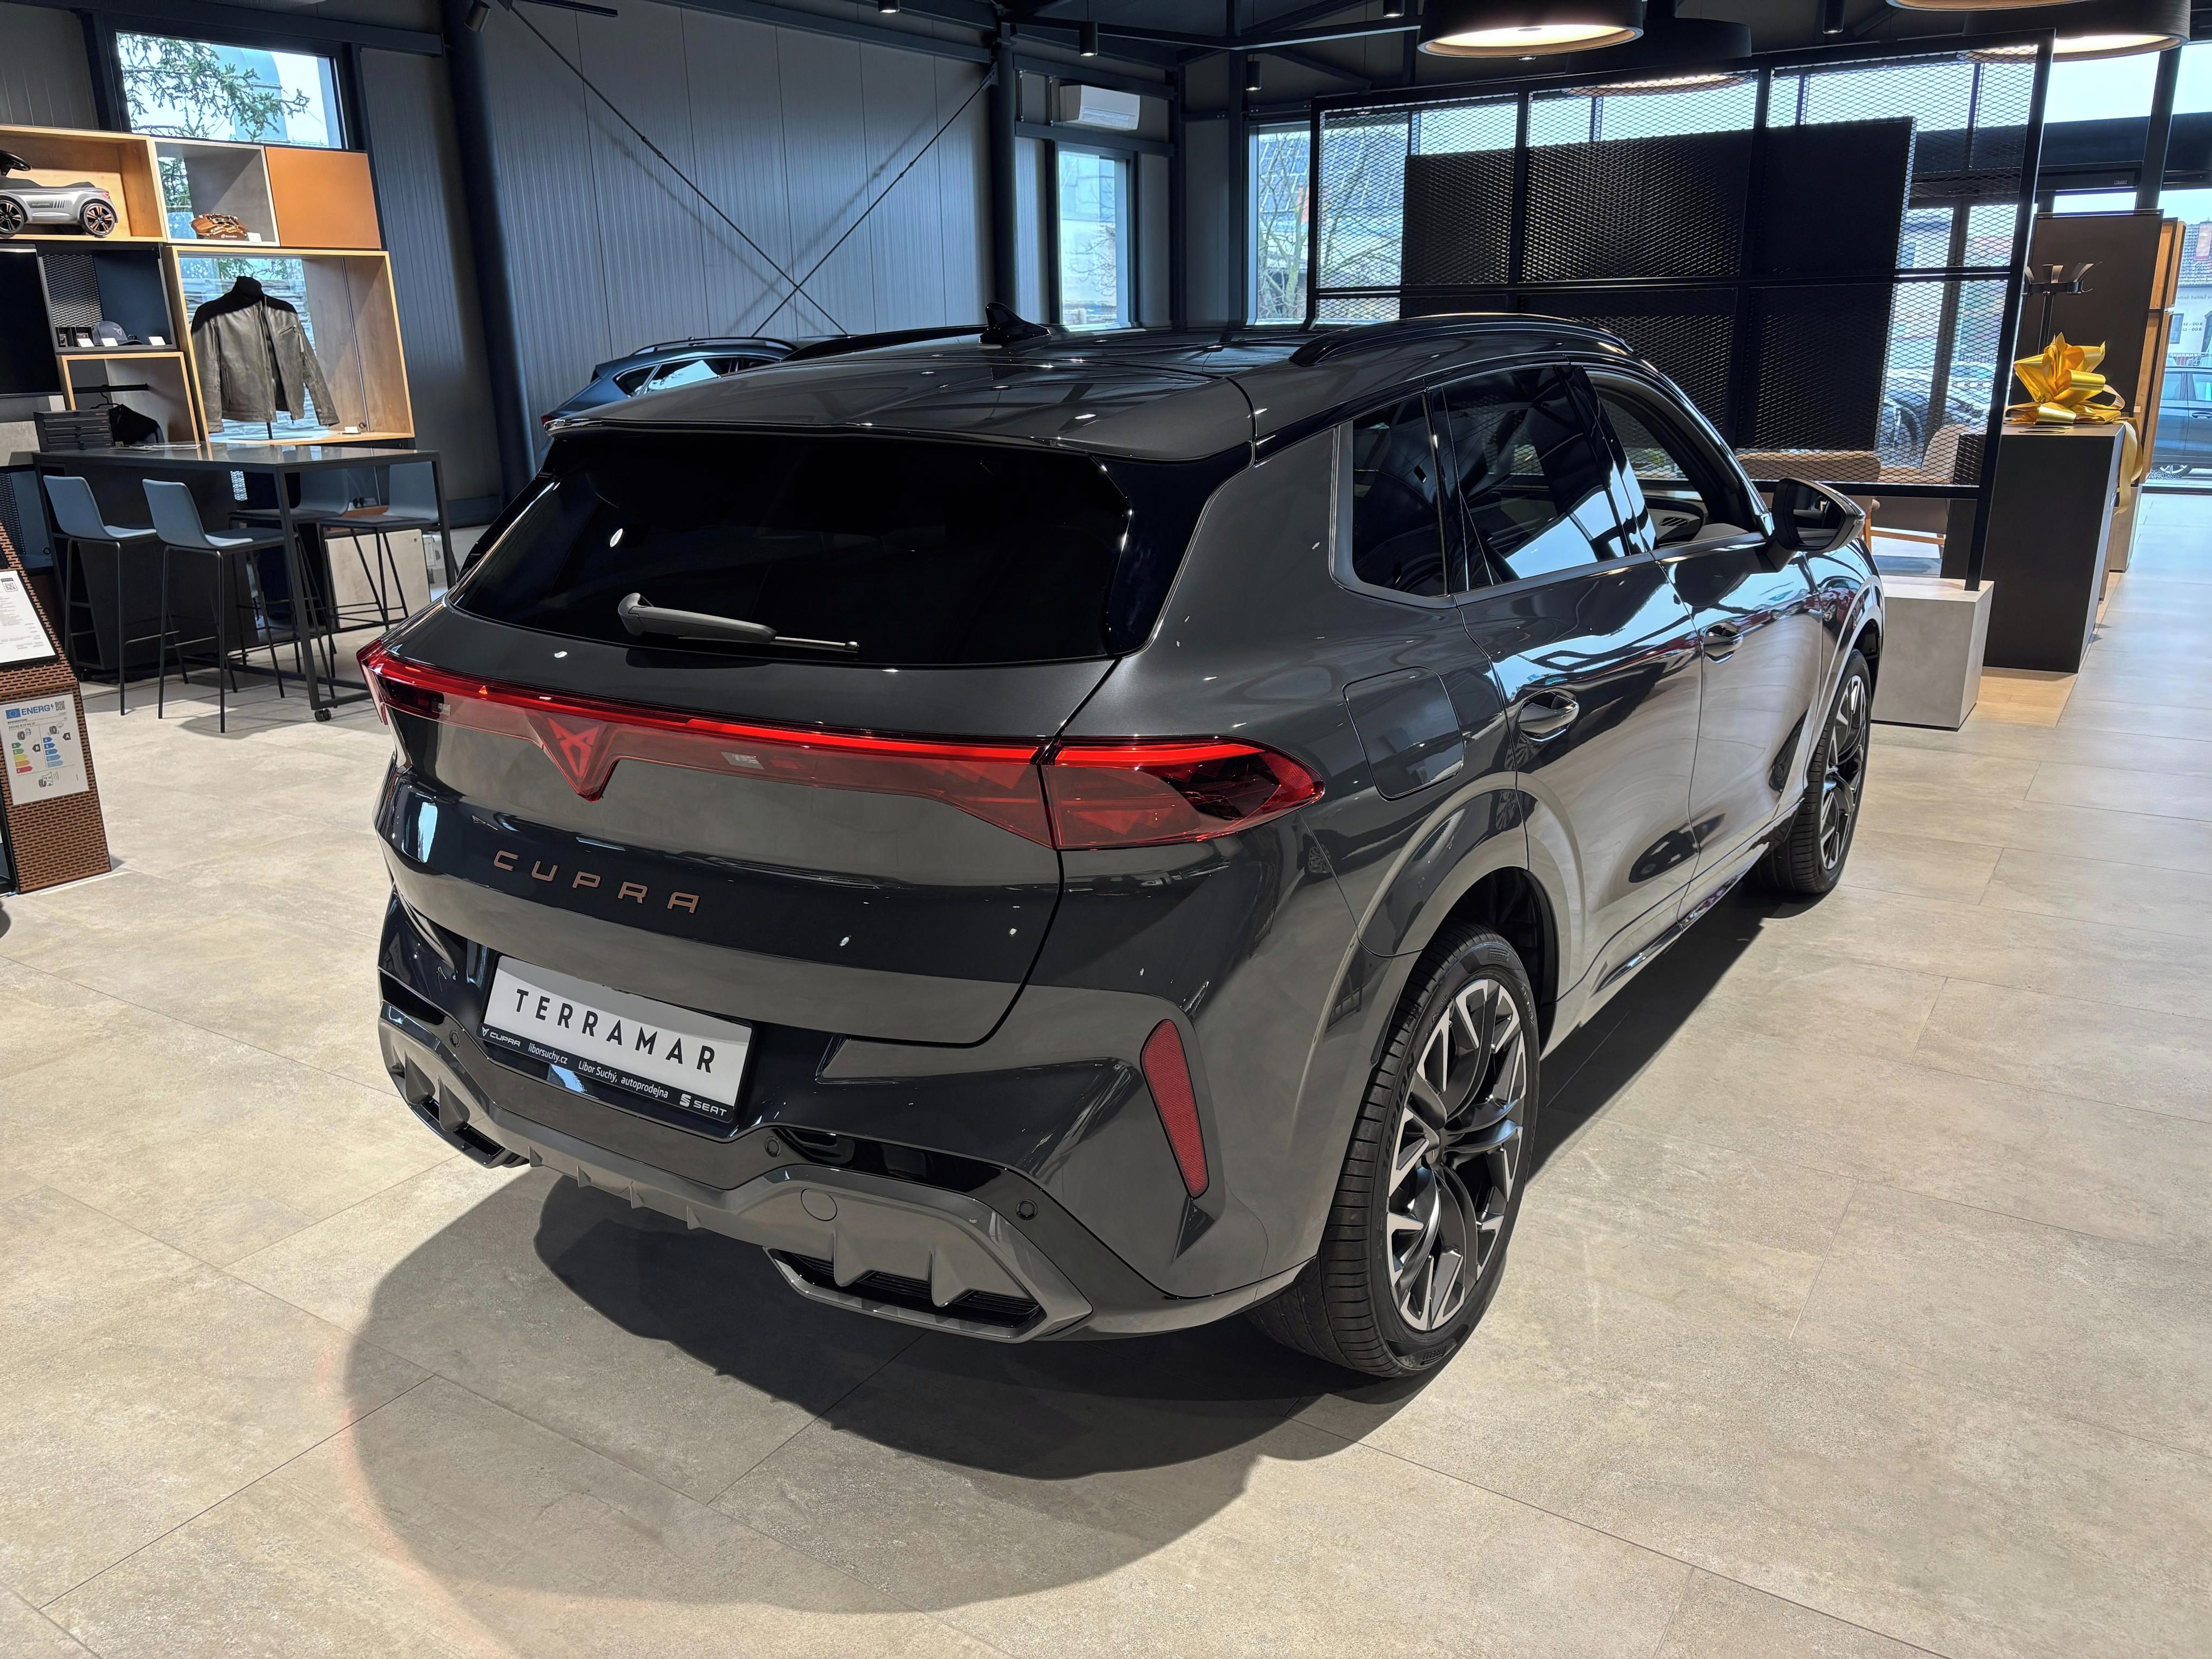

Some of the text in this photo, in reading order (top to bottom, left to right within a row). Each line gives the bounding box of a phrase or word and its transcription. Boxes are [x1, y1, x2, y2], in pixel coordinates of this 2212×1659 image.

[21, 704, 50, 716] ENERG
[493, 850, 701, 914] CUPRA
[515, 988, 716, 1074] TERRAMAR
[489, 1031, 727, 1116] CUPRA liborsuchy.cz Libor Suchý, autoprodejna SEAT
